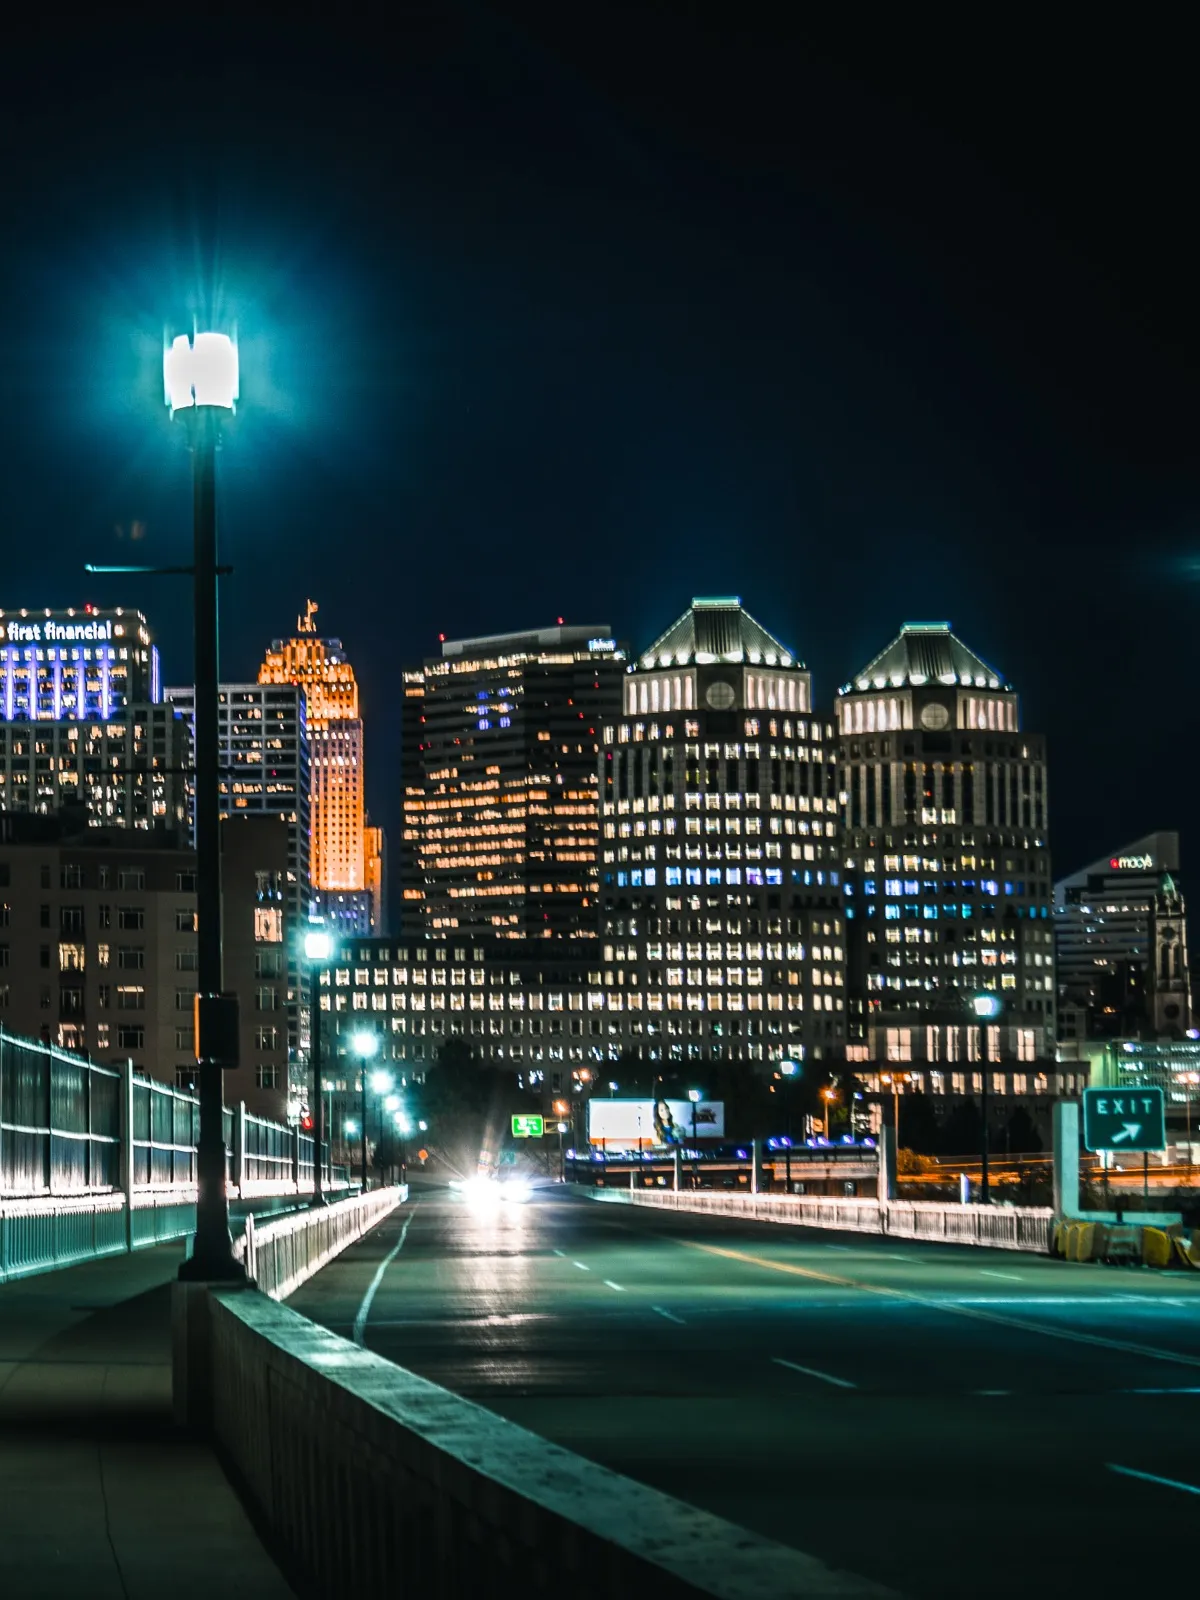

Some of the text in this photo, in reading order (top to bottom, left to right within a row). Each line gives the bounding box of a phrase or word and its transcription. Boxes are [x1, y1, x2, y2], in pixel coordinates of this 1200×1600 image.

[7, 619, 112, 641] first financial
[1096, 1099, 1152, 1115] EXIT
